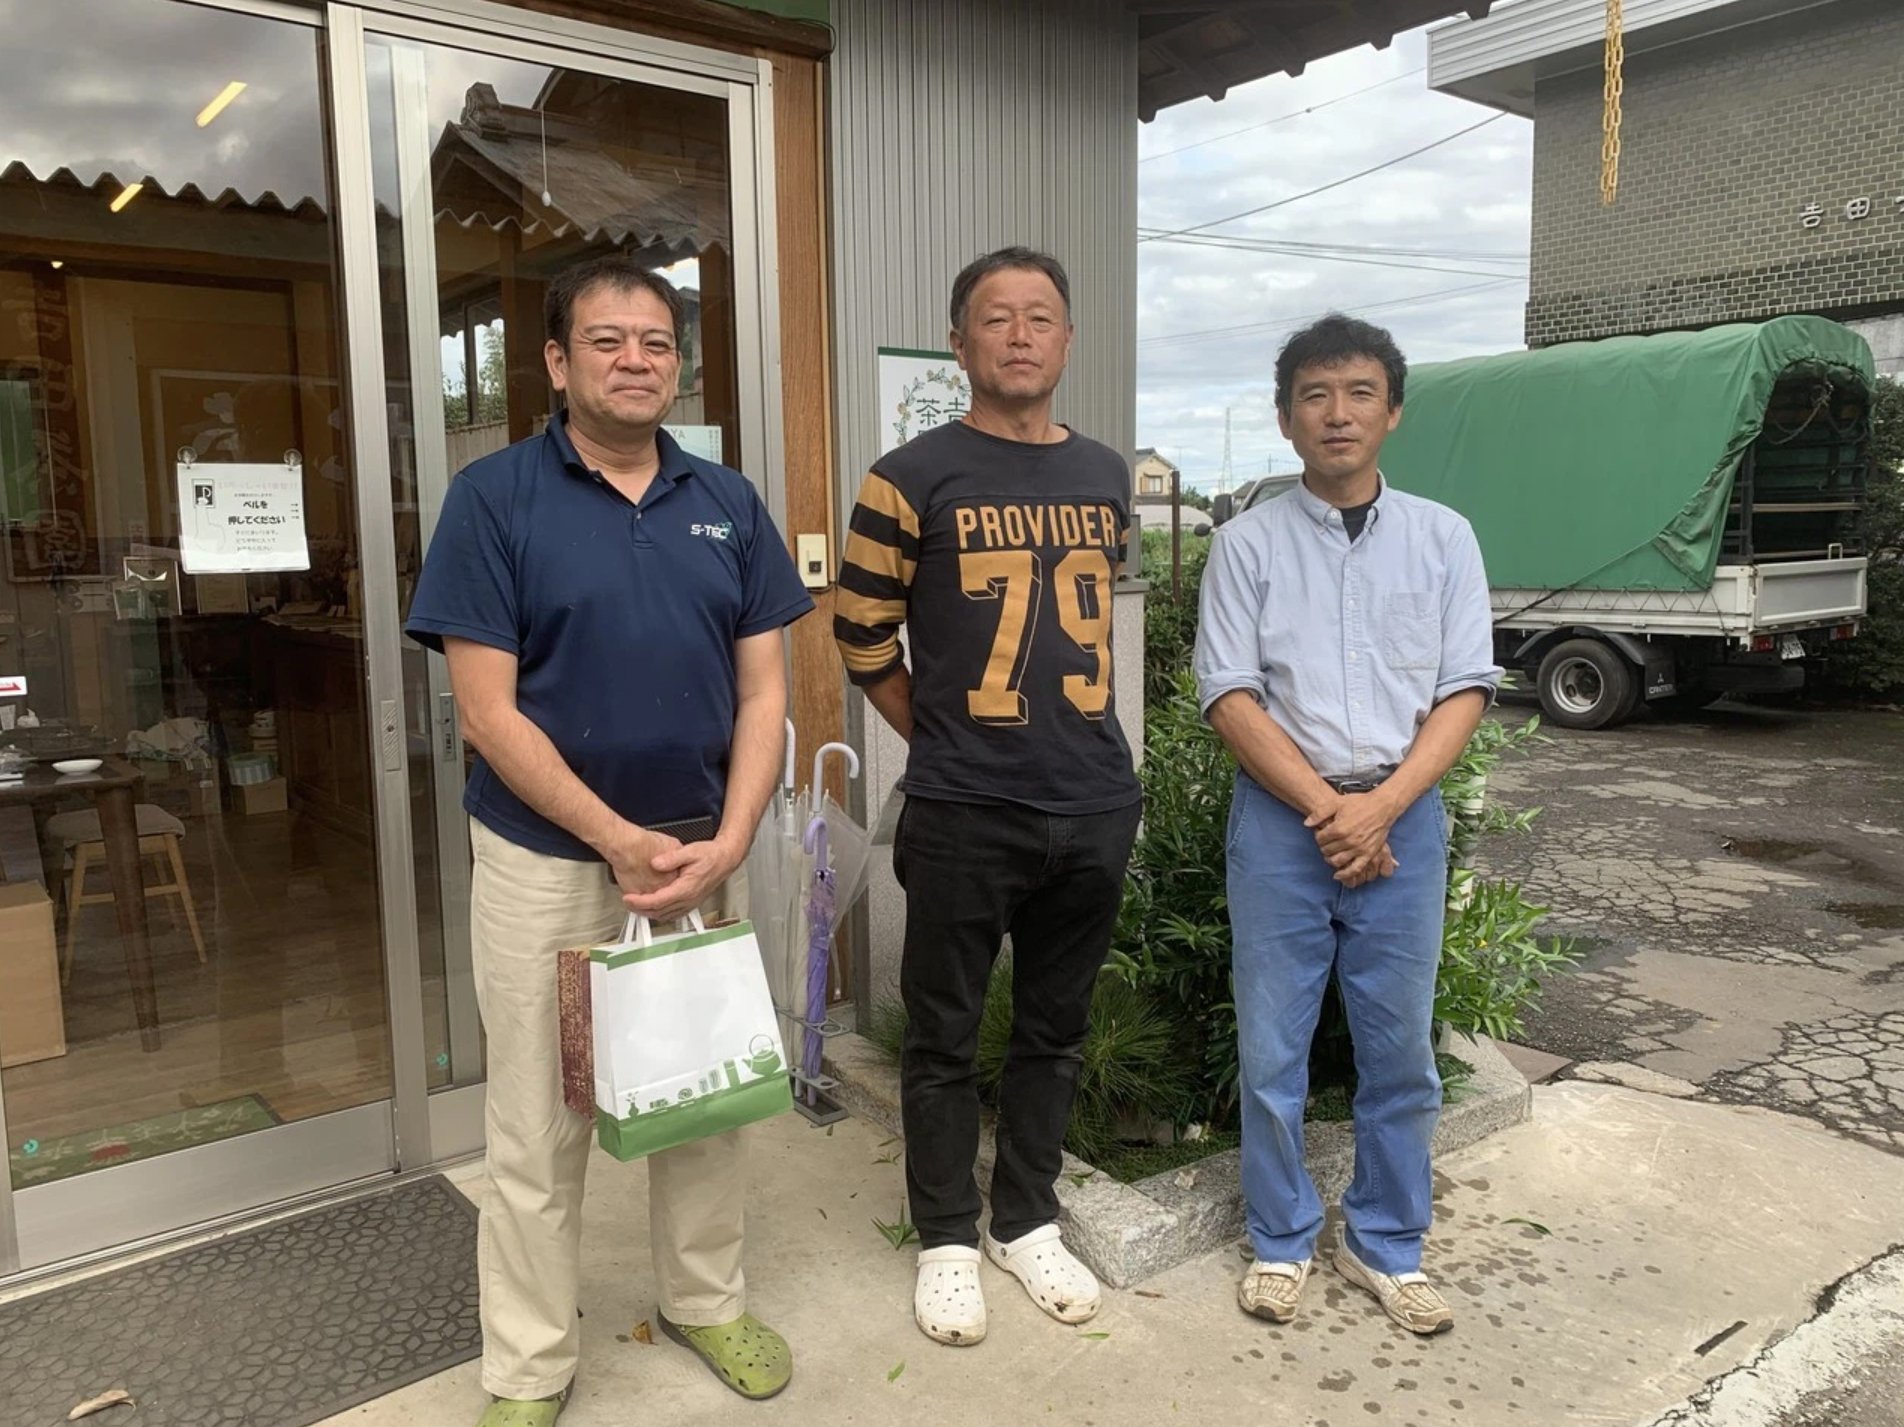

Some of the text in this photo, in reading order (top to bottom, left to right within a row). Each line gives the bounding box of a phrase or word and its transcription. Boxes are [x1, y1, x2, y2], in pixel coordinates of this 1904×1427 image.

[1799, 196, 1904, 229] 吉田
[242, 500, 269, 510] ベルを
[227, 515, 287, 526] 押してください
[690, 524, 729, 540] S-TEC
[955, 504, 1116, 549] PROVIDER
[958, 549, 1113, 727] 79
